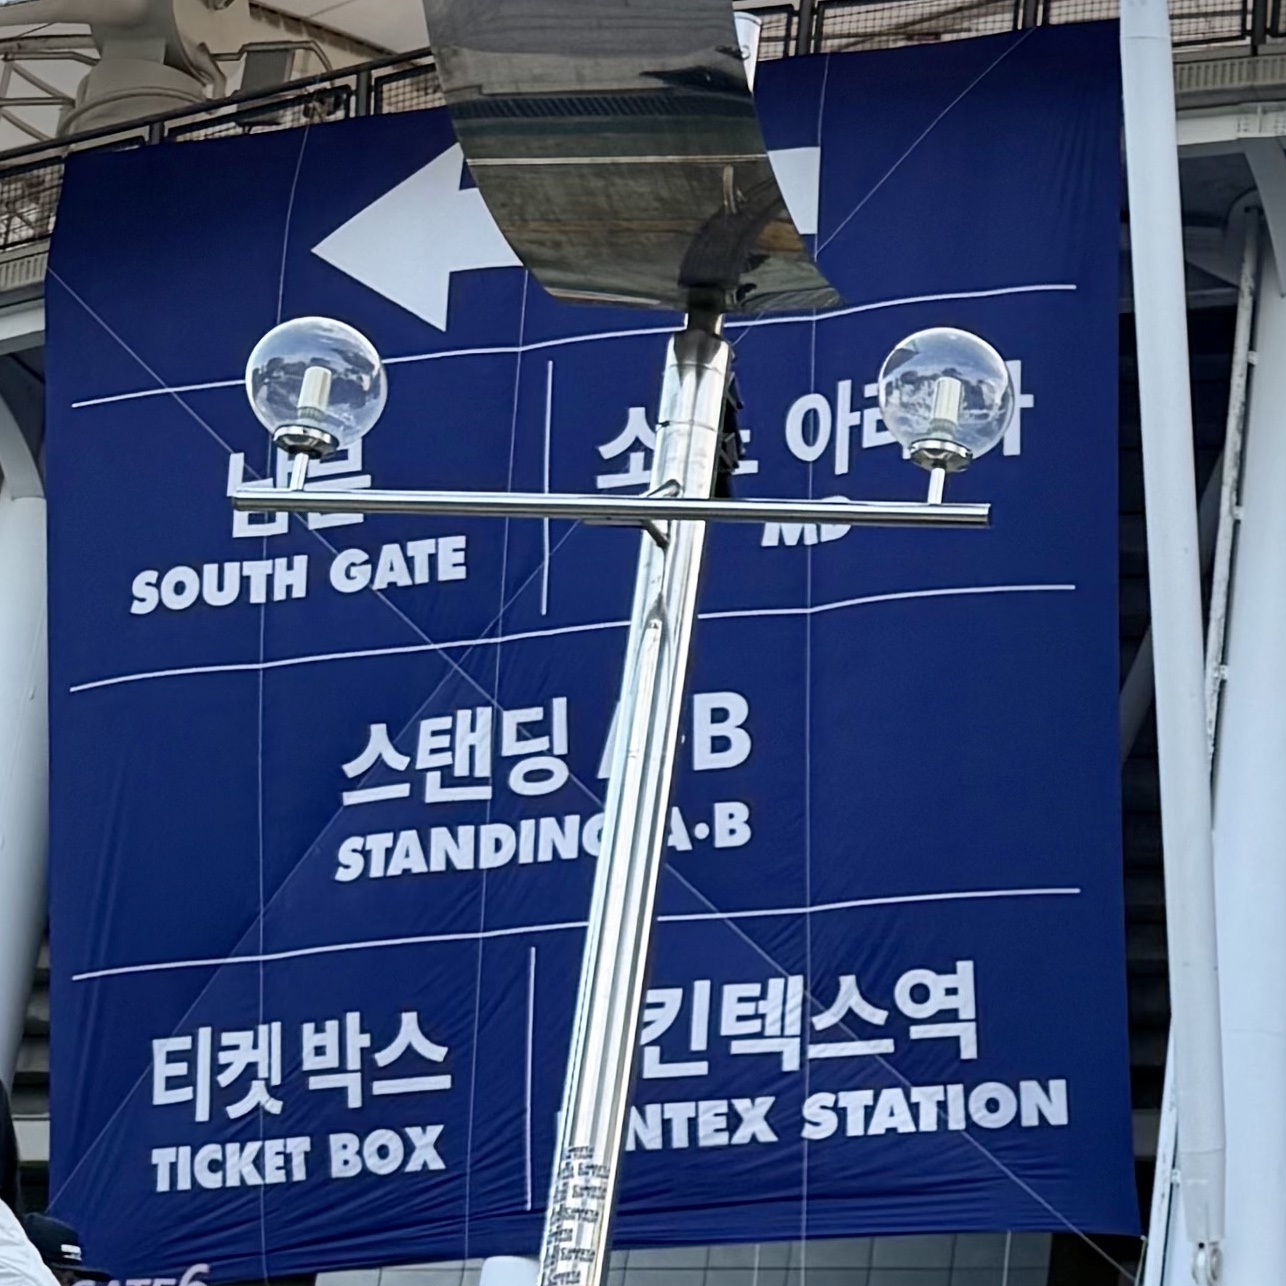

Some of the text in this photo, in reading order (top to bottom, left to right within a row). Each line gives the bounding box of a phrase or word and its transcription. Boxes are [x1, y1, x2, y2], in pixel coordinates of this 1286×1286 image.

[132, 537, 466, 615] SOUTH GATE
[344, 699, 569, 806] 스탠딩
[641, 961, 977, 1079] 킨텍스역
[154, 1013, 452, 1122] 티켓 박스
[803, 1081, 1068, 1140] STATION
[153, 1126, 446, 1192] TICKET BOX
